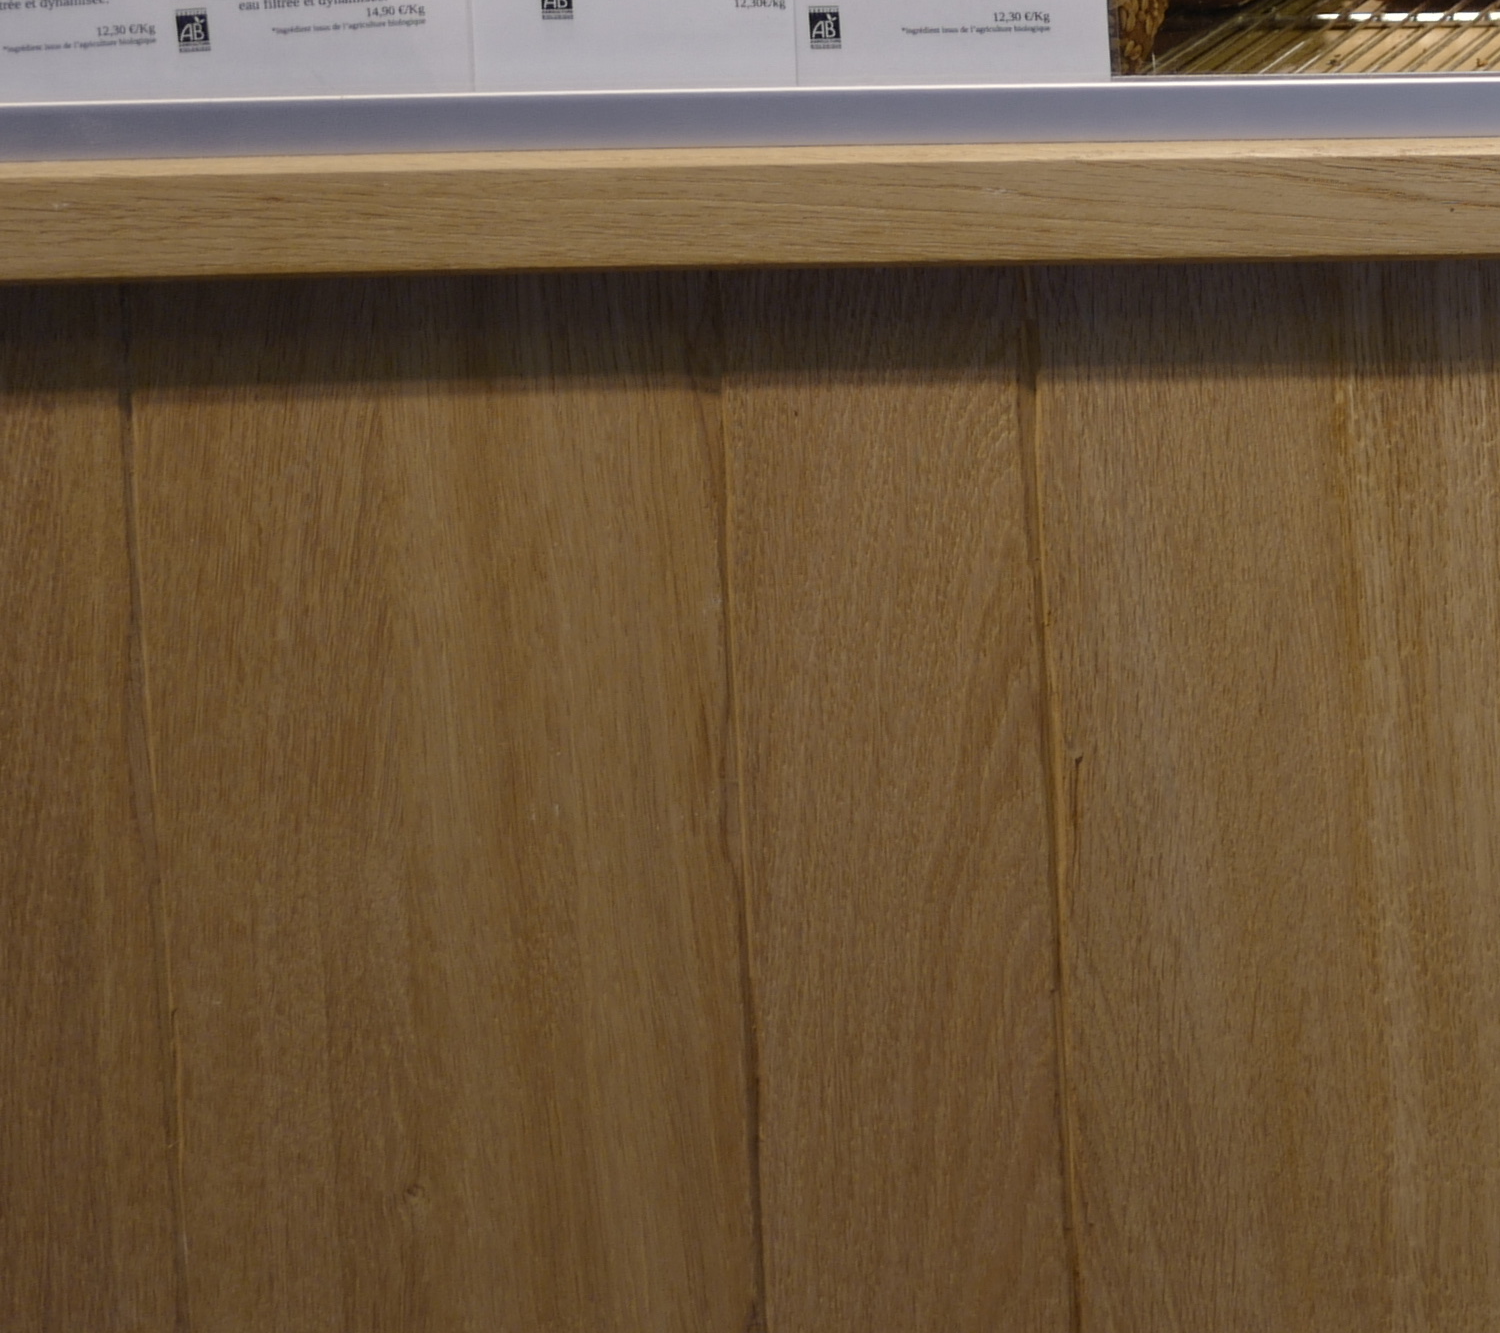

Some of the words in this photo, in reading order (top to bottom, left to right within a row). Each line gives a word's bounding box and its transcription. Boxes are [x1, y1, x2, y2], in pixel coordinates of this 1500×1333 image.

[238, 1, 260, 11] eau
[366, 6, 396, 18] 14,90
[993, 11, 1022, 24] 12,30
[96, 24, 127, 38] 12,30
